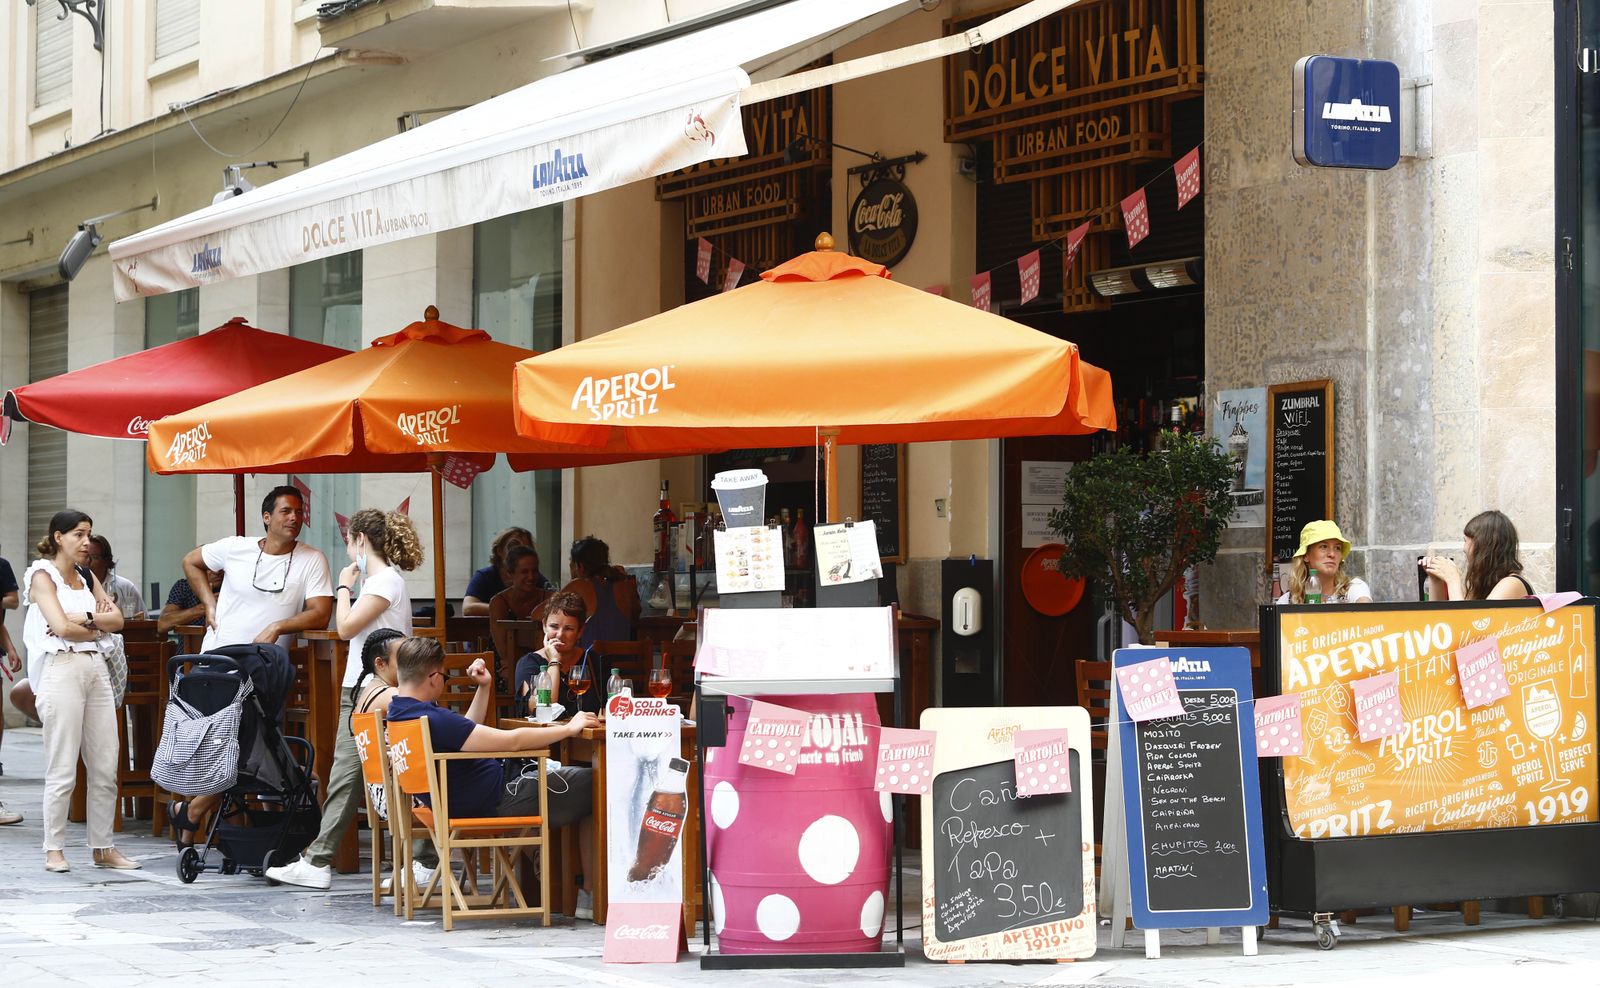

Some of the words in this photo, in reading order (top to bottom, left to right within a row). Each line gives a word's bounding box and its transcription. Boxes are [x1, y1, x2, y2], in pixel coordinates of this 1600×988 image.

[963, 47, 1067, 115] DOLCE
[1085, 24, 1167, 85] VITA
[753, 105, 813, 157] VITA
[1016, 123, 1067, 157] URBAN
[1076, 116, 1120, 146] FOOD
[532, 149, 589, 189] LAVAZZA
[702, 192, 740, 216] URBAN
[747, 182, 781, 208] FOOD
[302, 216, 346, 253] DOLCE
[352, 208, 384, 239] VITA
[384, 220, 408, 233] URBAN
[409, 212, 428, 229] FOOD
[571, 364, 675, 410] APEROL
[397, 405, 460, 436] APEROL
[165, 421, 212, 458] APEROL
[740, 473, 759, 482] AWAY
[1288, 640, 1308, 657] THE
[1312, 625, 1362, 650] ORIGINAL
[1503, 625, 1564, 664] original
[1170, 656, 1211, 672] VAZZA
[1288, 622, 1452, 690] APERITIVO
[1462, 650, 1497, 681] CARTOJAL
[1507, 660, 1565, 686] ORIGINALE
[634, 700, 663, 708] COLD
[634, 708, 677, 716] DRINKS
[1357, 685, 1396, 712] CARTOJAL
[749, 722, 801, 737] CARTOJAL
[1471, 705, 1506, 725] PADOVA
[801, 713, 868, 752] TOJAL
[1379, 707, 1467, 757] APEROL
[881, 747, 931, 762] CARTOJAL
[1018, 741, 1065, 764] CARTOJAL
[1558, 743, 1592, 762] PERFECT
[1561, 759, 1585, 774] SERVE
[1335, 762, 1375, 783] APERITIVO
[1462, 770, 1498, 786] SPONTANEOUS
[1511, 758, 1543, 777] APEROL
[1517, 770, 1544, 787] SPRITZ
[1347, 783, 1364, 795] 1919
[1405, 800, 1438, 819] RICETTA
[1442, 786, 1484, 807] ORIGINALE
[1292, 799, 1394, 838] SPRITZ
[1293, 802, 1337, 822] SPONTANEOUS
[1433, 791, 1516, 826] Contagious
[1524, 786, 1588, 825] 1919
[941, 816, 1030, 848] Refresco
[1002, 919, 1084, 945] APERITIVO
[1026, 935, 1060, 952] 1919
